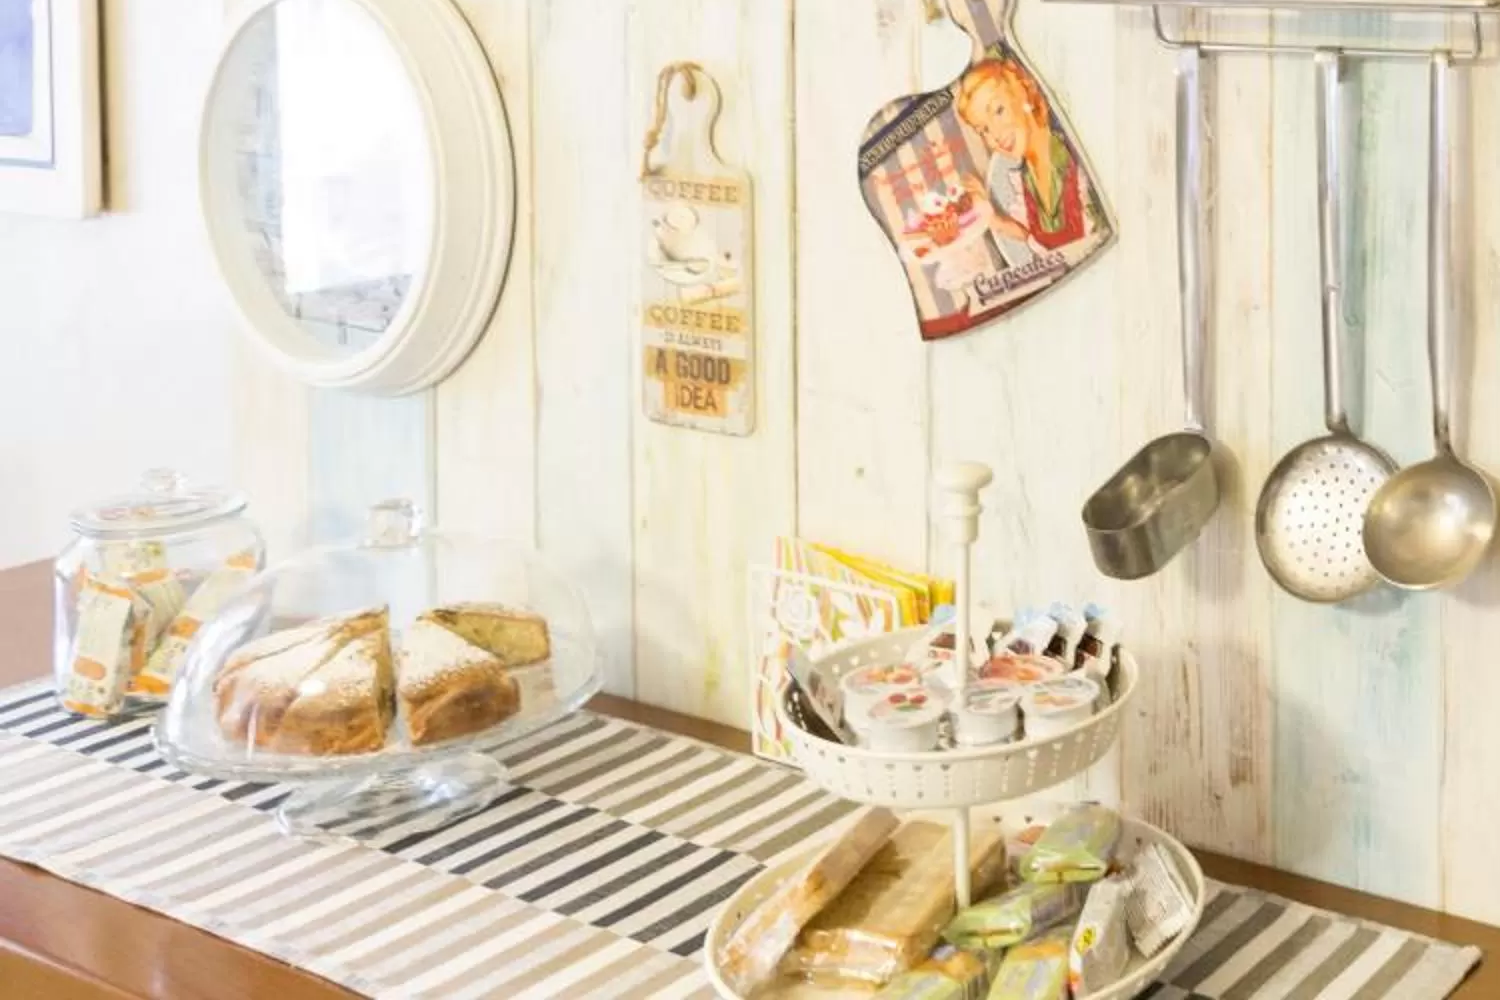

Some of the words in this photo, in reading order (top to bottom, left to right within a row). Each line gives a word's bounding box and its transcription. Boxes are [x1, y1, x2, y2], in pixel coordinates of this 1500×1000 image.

[649, 178, 740, 204] COFFEE
[649, 304, 741, 333] COFFEE
[655, 348, 668, 376] A
[675, 351, 732, 385] GOOD
